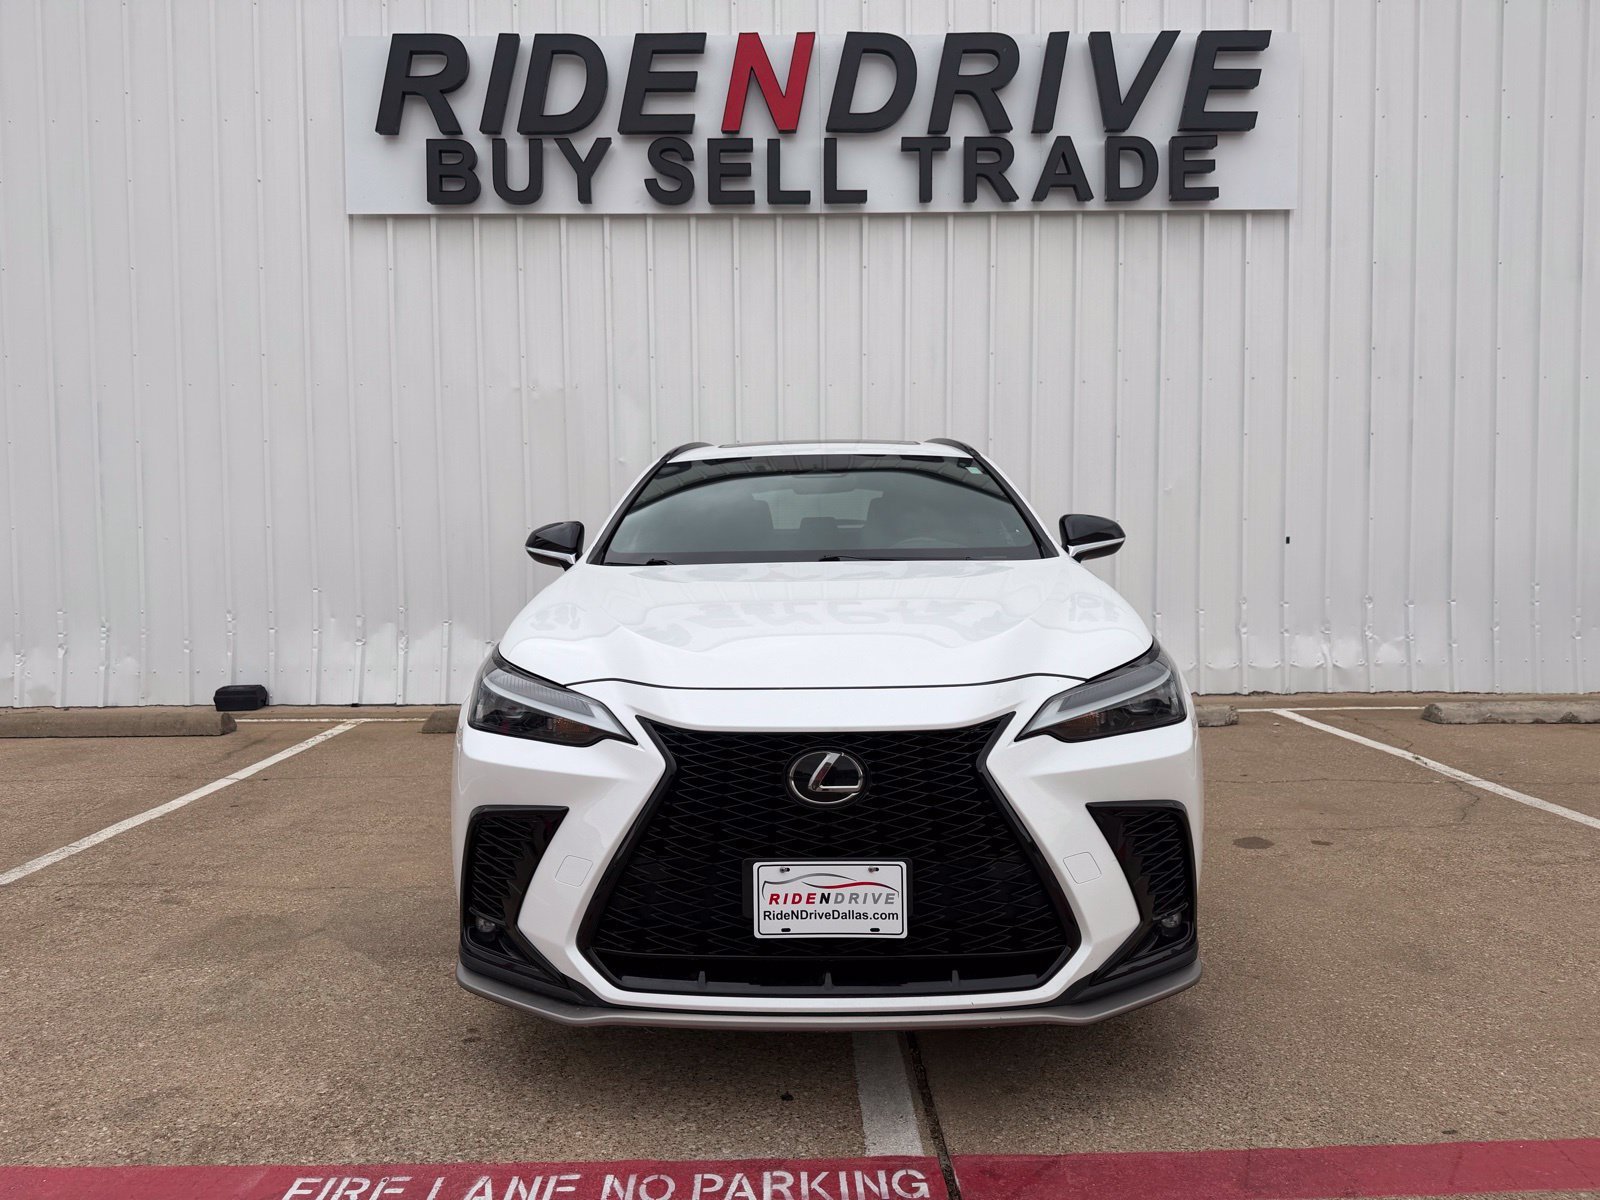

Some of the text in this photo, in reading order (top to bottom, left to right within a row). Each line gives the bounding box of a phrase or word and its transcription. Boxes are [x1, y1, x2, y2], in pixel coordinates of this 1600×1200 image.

[426, 135, 1219, 204] BUY SELL TRADE
[763, 910, 899, 920] RideNDriveDallas.com
[601, 1173, 676, 1200] NO
[694, 1169, 931, 1200] PARKING
